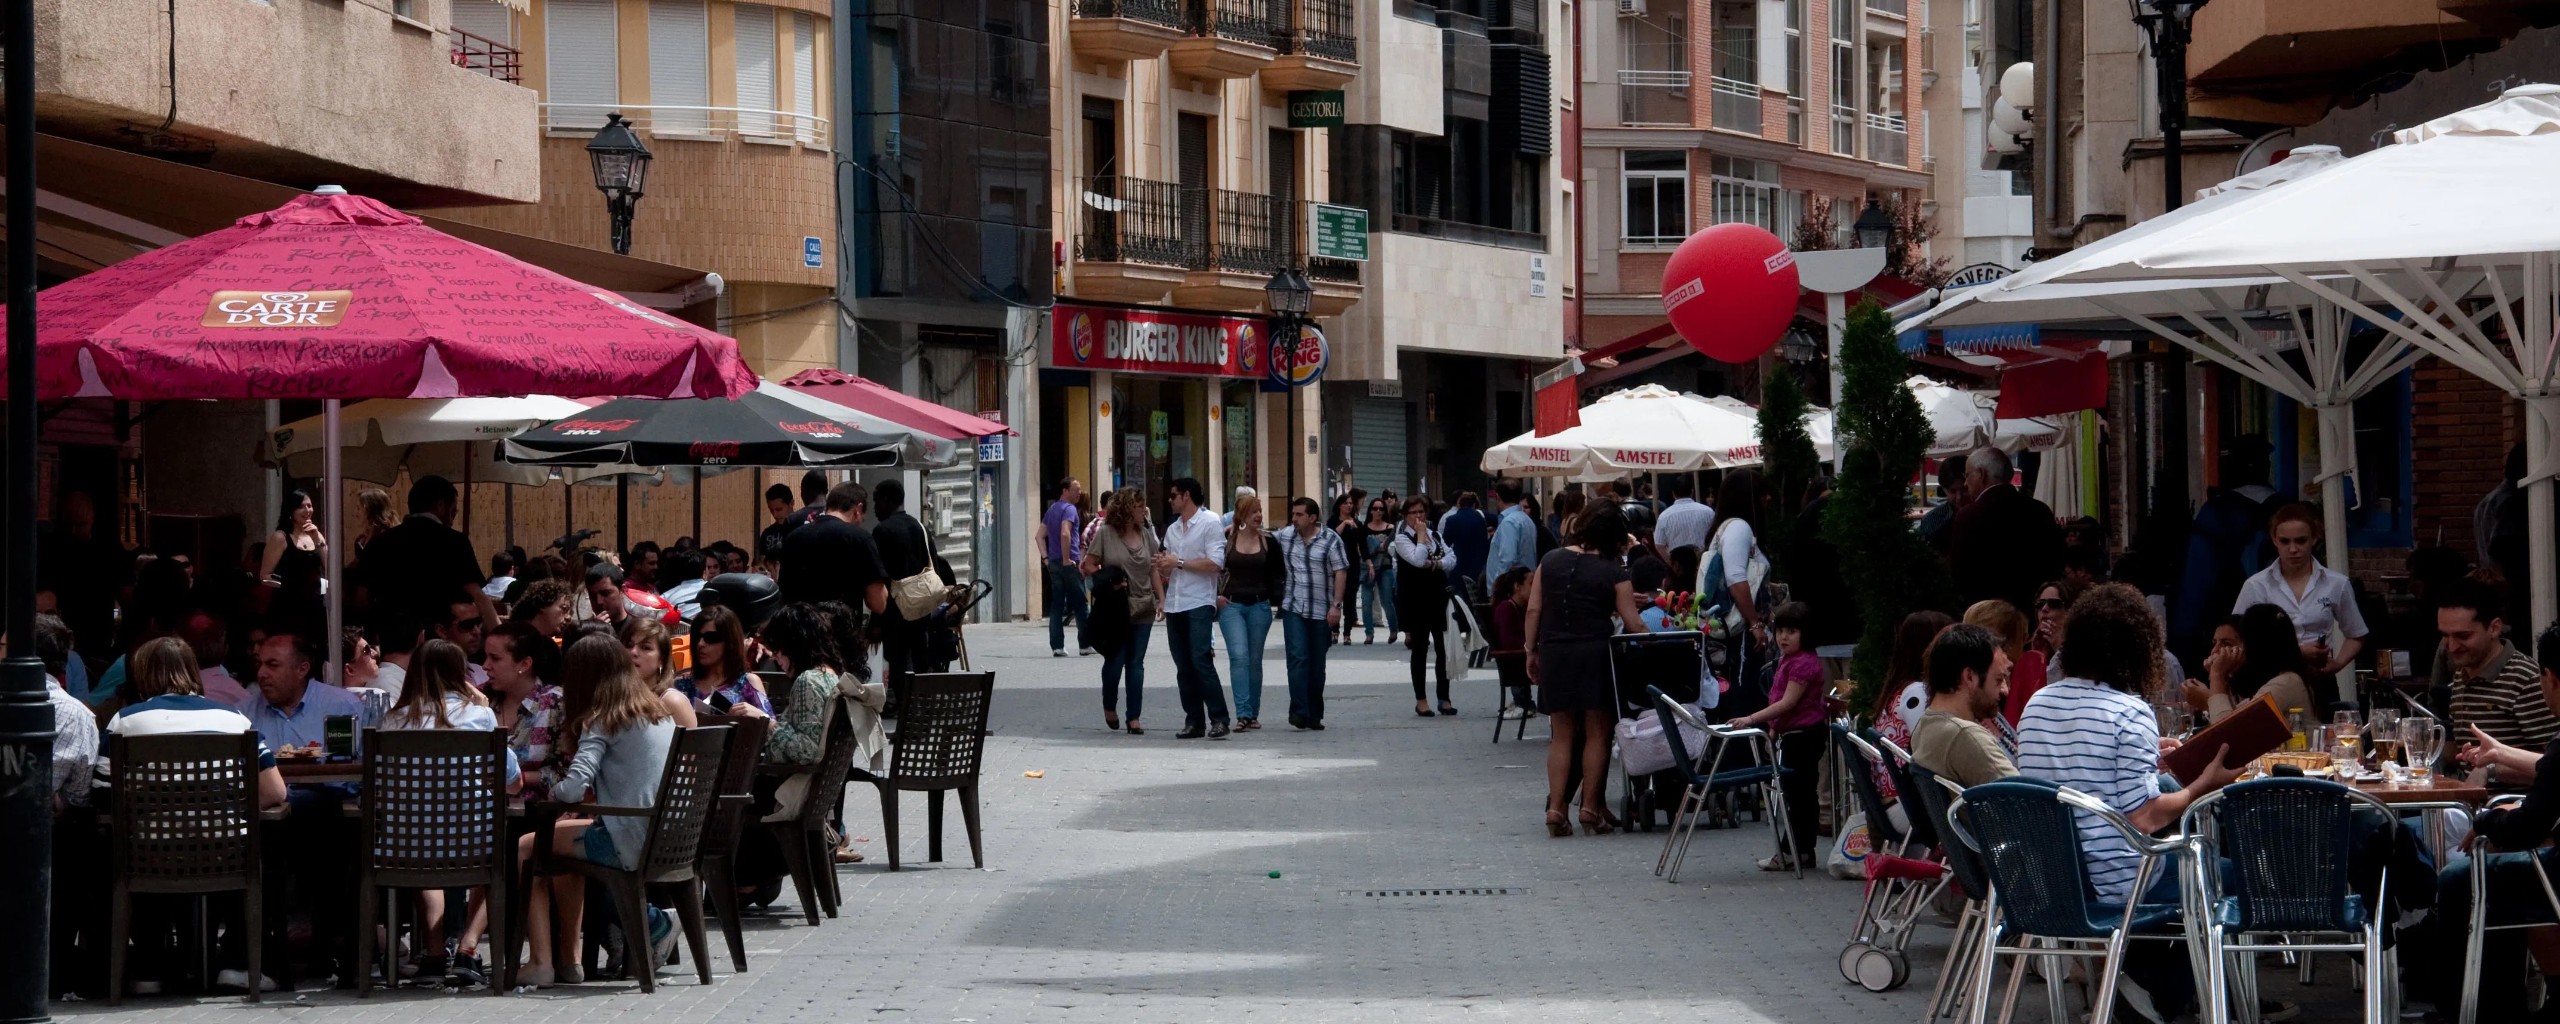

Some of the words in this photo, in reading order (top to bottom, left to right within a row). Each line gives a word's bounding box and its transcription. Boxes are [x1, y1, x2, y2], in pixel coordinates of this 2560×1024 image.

[1292, 102, 1344, 118] GESTORIA
[217, 300, 338, 315] CARTE
[226, 313, 321, 326] D'OR
[120, 324, 201, 338] Coffee
[466, 331, 547, 345] Caramello
[1104, 319, 1180, 363] BURGER
[1183, 325, 1229, 366] KING
[1275, 348, 1320, 373] KNG
[703, 456, 727, 465] zero
[980, 446, 993, 461] 967
[1530, 446, 1571, 462] AMSTEL
[1614, 449, 1675, 465] AMSTEL
